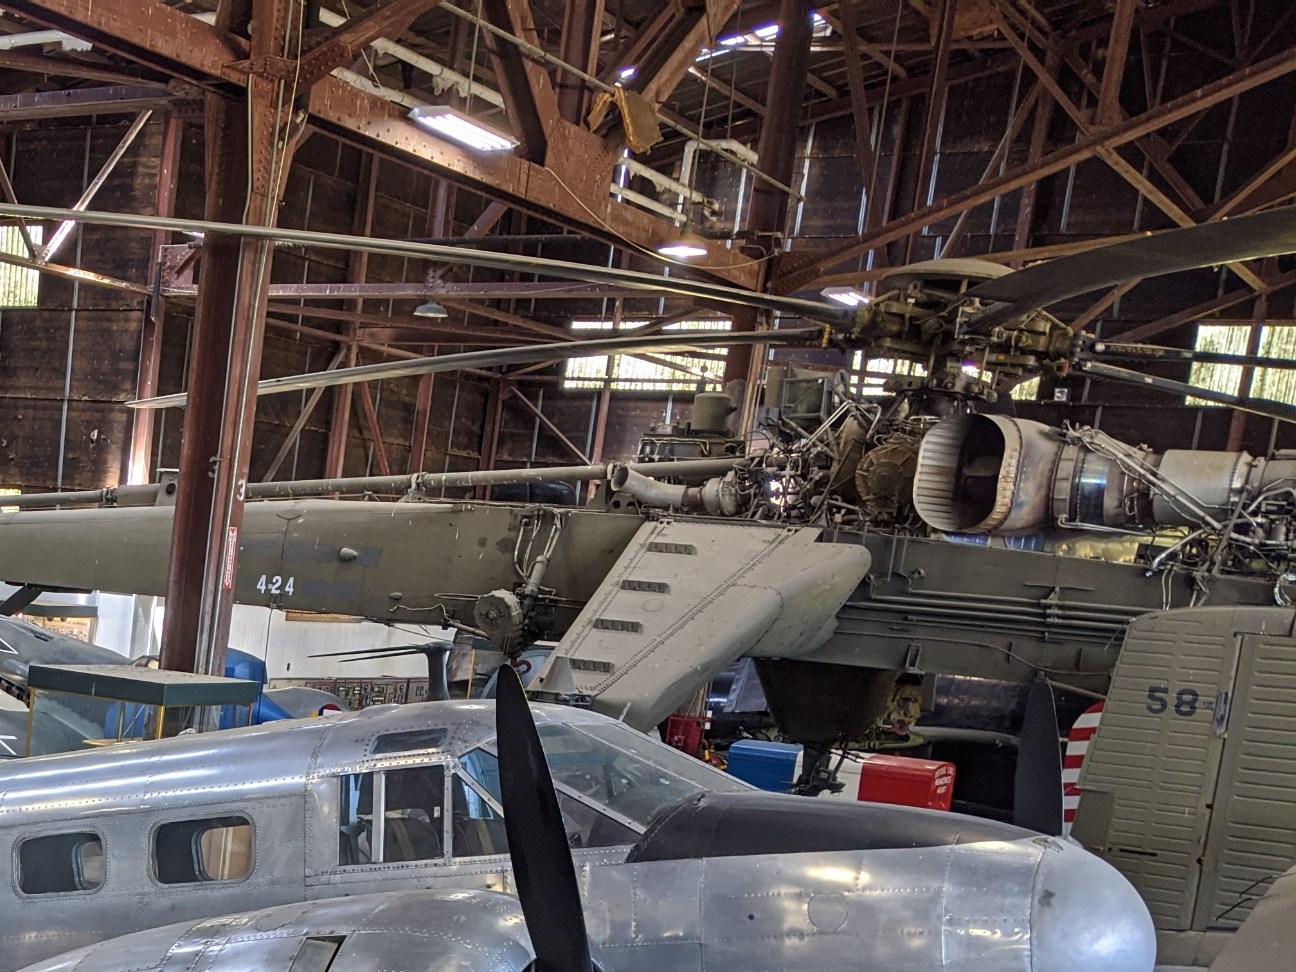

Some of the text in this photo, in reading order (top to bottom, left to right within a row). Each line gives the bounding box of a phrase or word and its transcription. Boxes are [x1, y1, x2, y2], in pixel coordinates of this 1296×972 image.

[236, 479, 247, 501] 3
[256, 574, 295, 596] 4-24
[1146, 686, 1200, 717] 58
